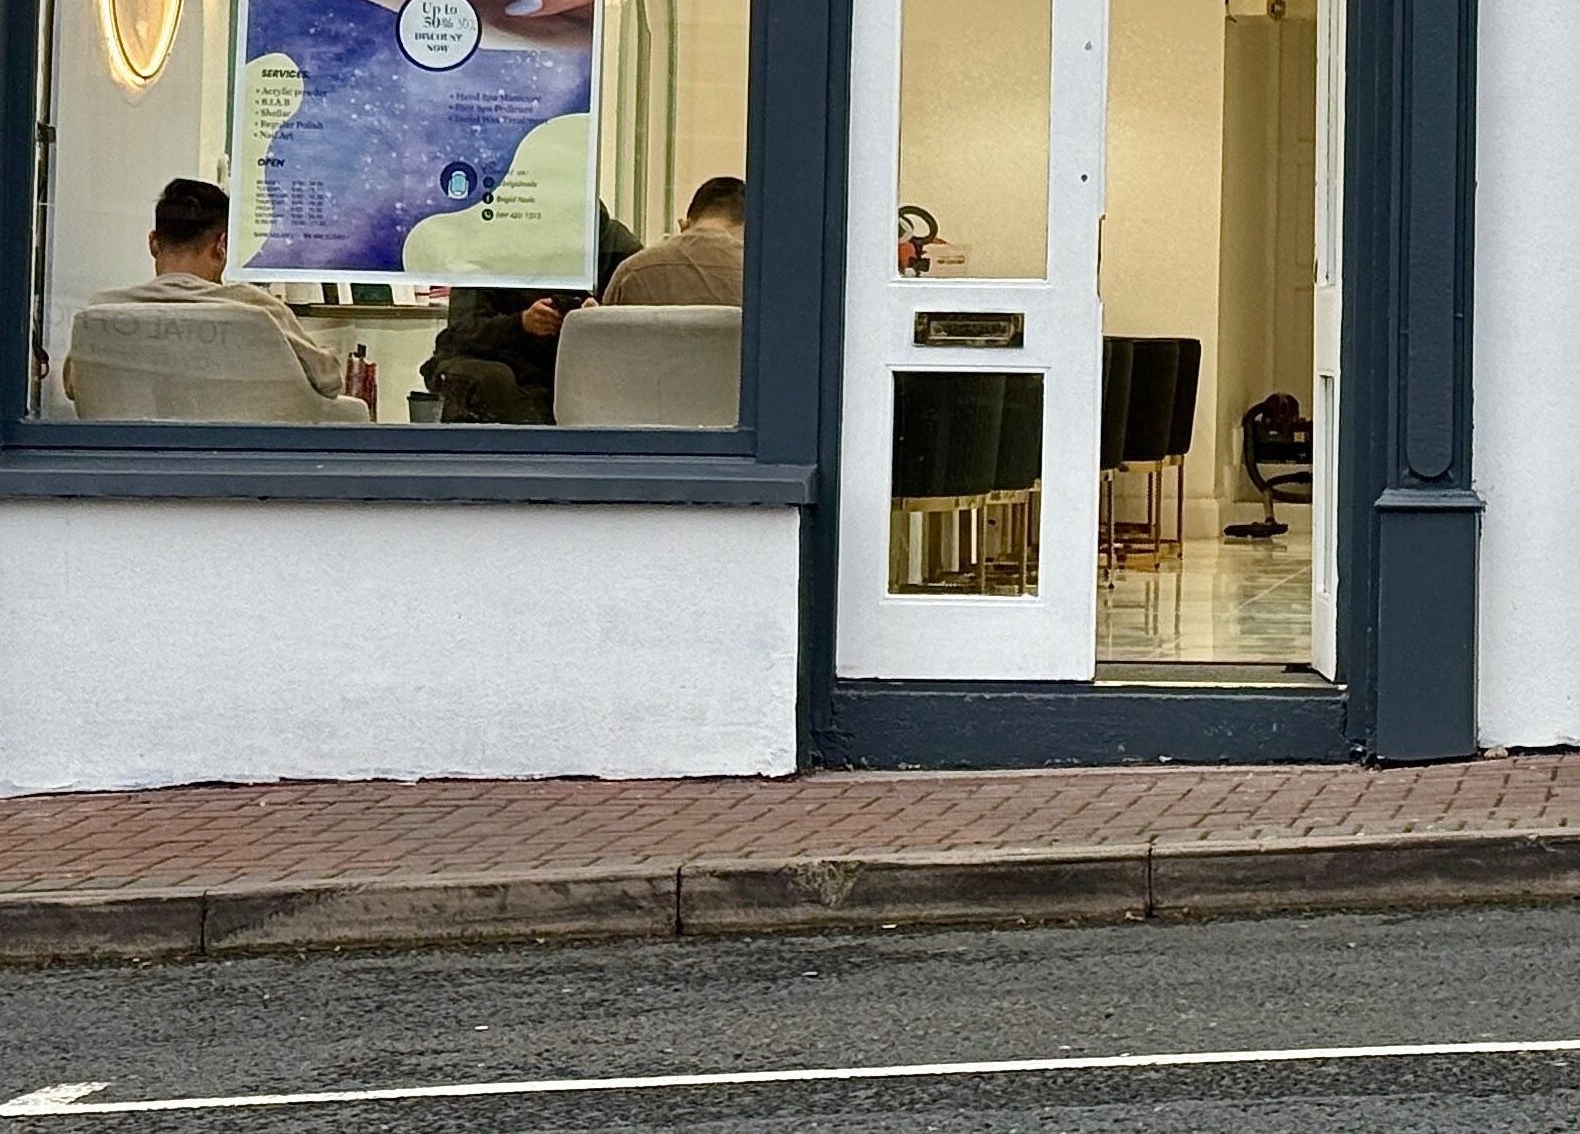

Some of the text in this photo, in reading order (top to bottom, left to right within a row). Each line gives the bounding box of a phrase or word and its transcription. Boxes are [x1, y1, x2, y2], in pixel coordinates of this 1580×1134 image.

[423, 2, 458, 18] Up to
[257, 158, 286, 167] OPEN
